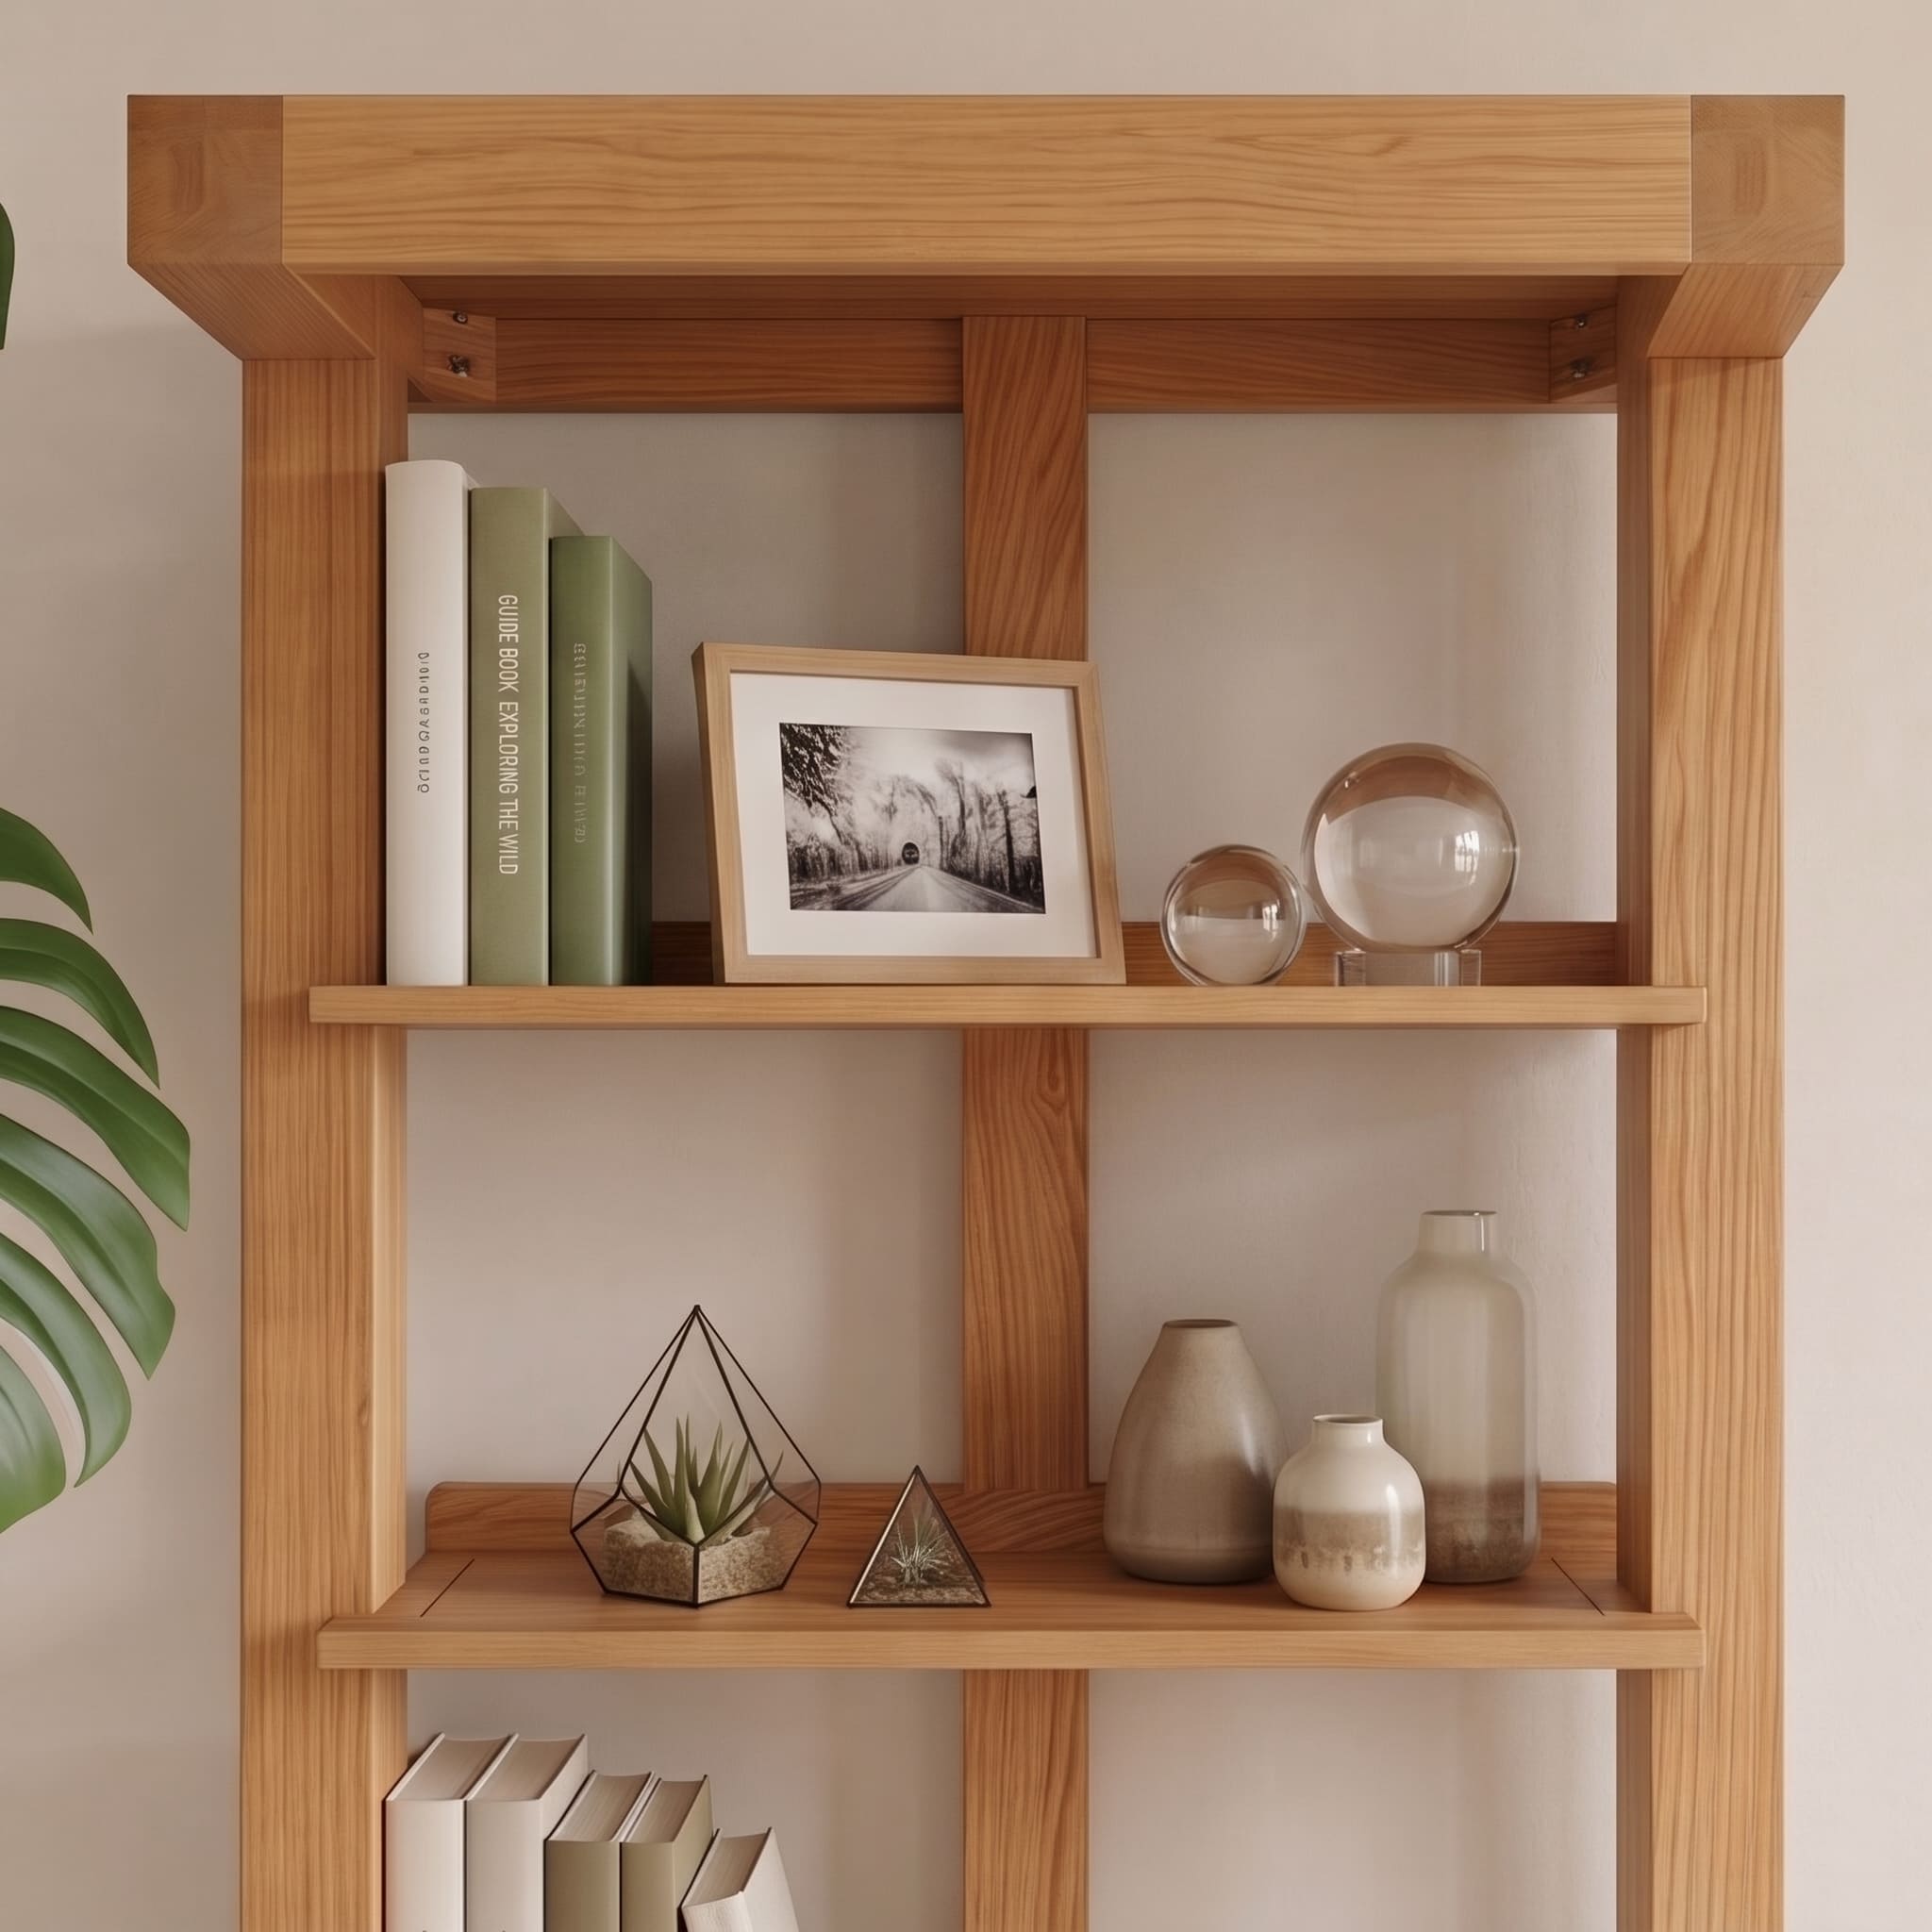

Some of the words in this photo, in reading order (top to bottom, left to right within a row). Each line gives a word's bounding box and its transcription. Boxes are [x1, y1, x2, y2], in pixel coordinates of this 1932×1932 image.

[498, 594, 519, 643] GUIDE
[498, 647, 519, 692] BOOK
[498, 701, 519, 794] EXPLORING
[498, 798, 519, 831] THE
[498, 833, 519, 874] WILD
